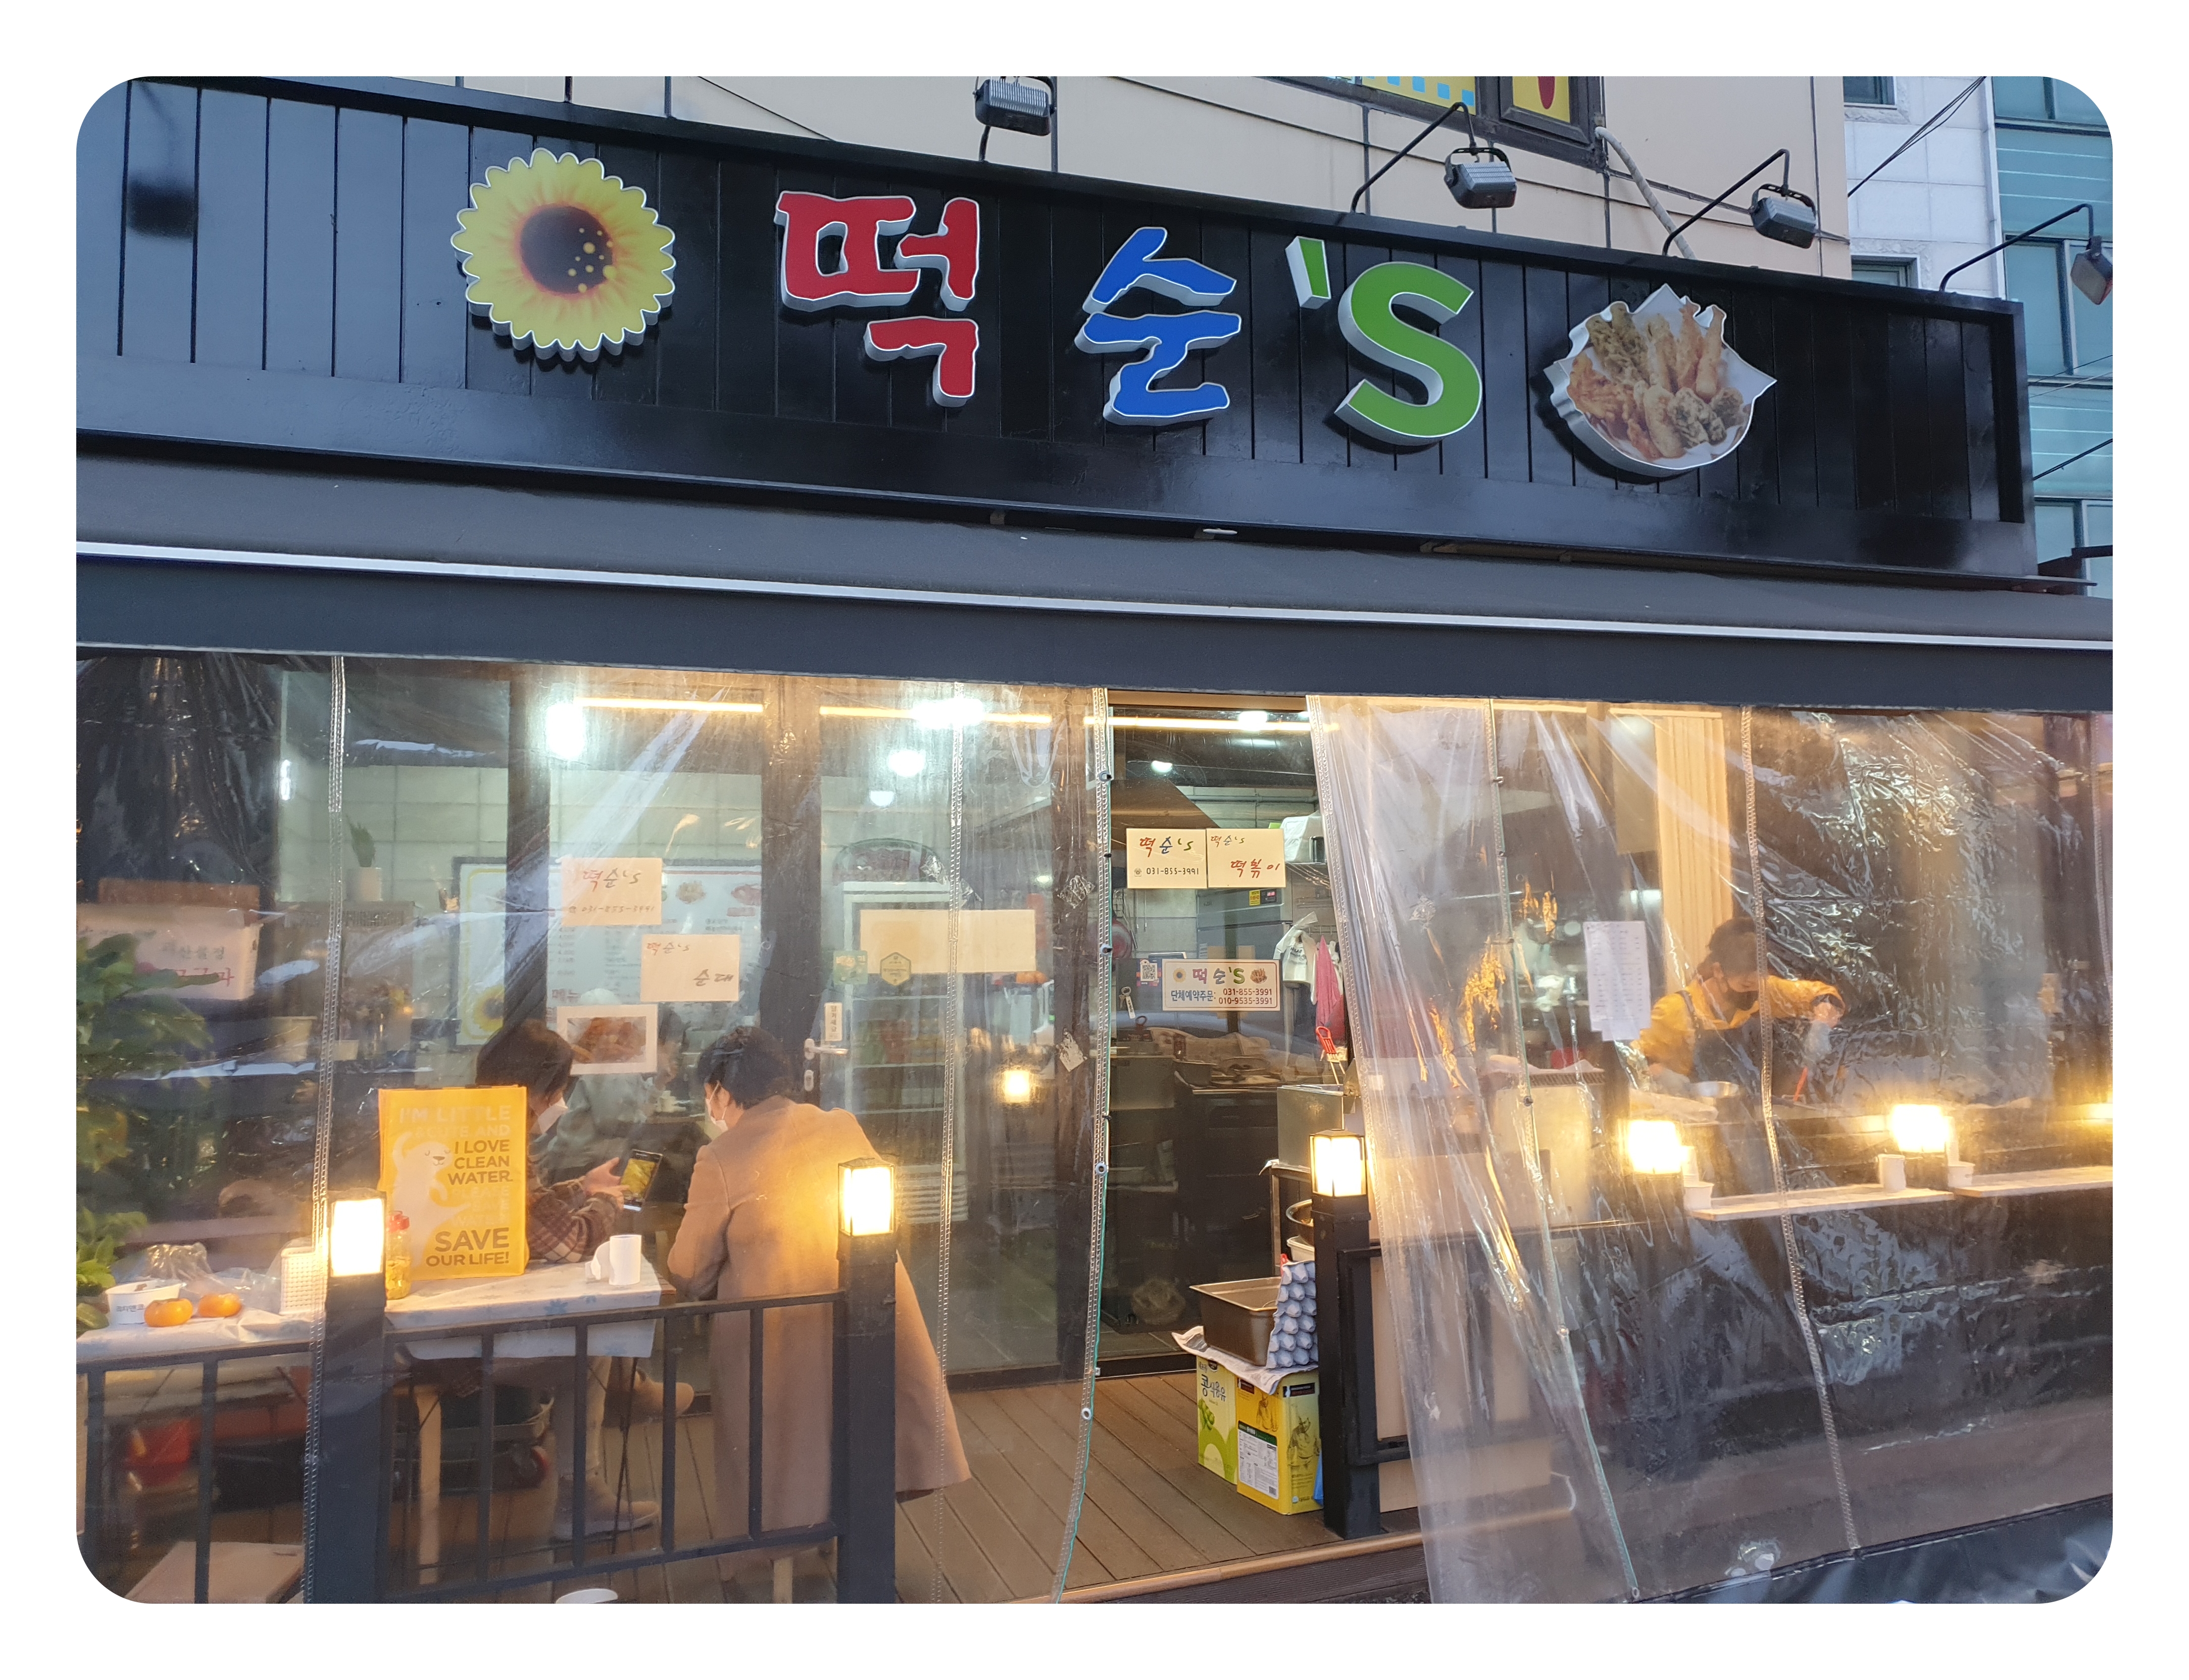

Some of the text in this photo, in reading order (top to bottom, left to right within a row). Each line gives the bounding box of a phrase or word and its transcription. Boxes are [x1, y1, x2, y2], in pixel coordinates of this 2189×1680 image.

[692, 969, 734, 986] 순대
[475, 1124, 511, 1137] AND
[455, 1139, 510, 1154] I LOVE
[454, 1156, 510, 1169] CLEAN
[435, 1227, 509, 1252] SAVE
[426, 1252, 509, 1267] OUR LIFE!
